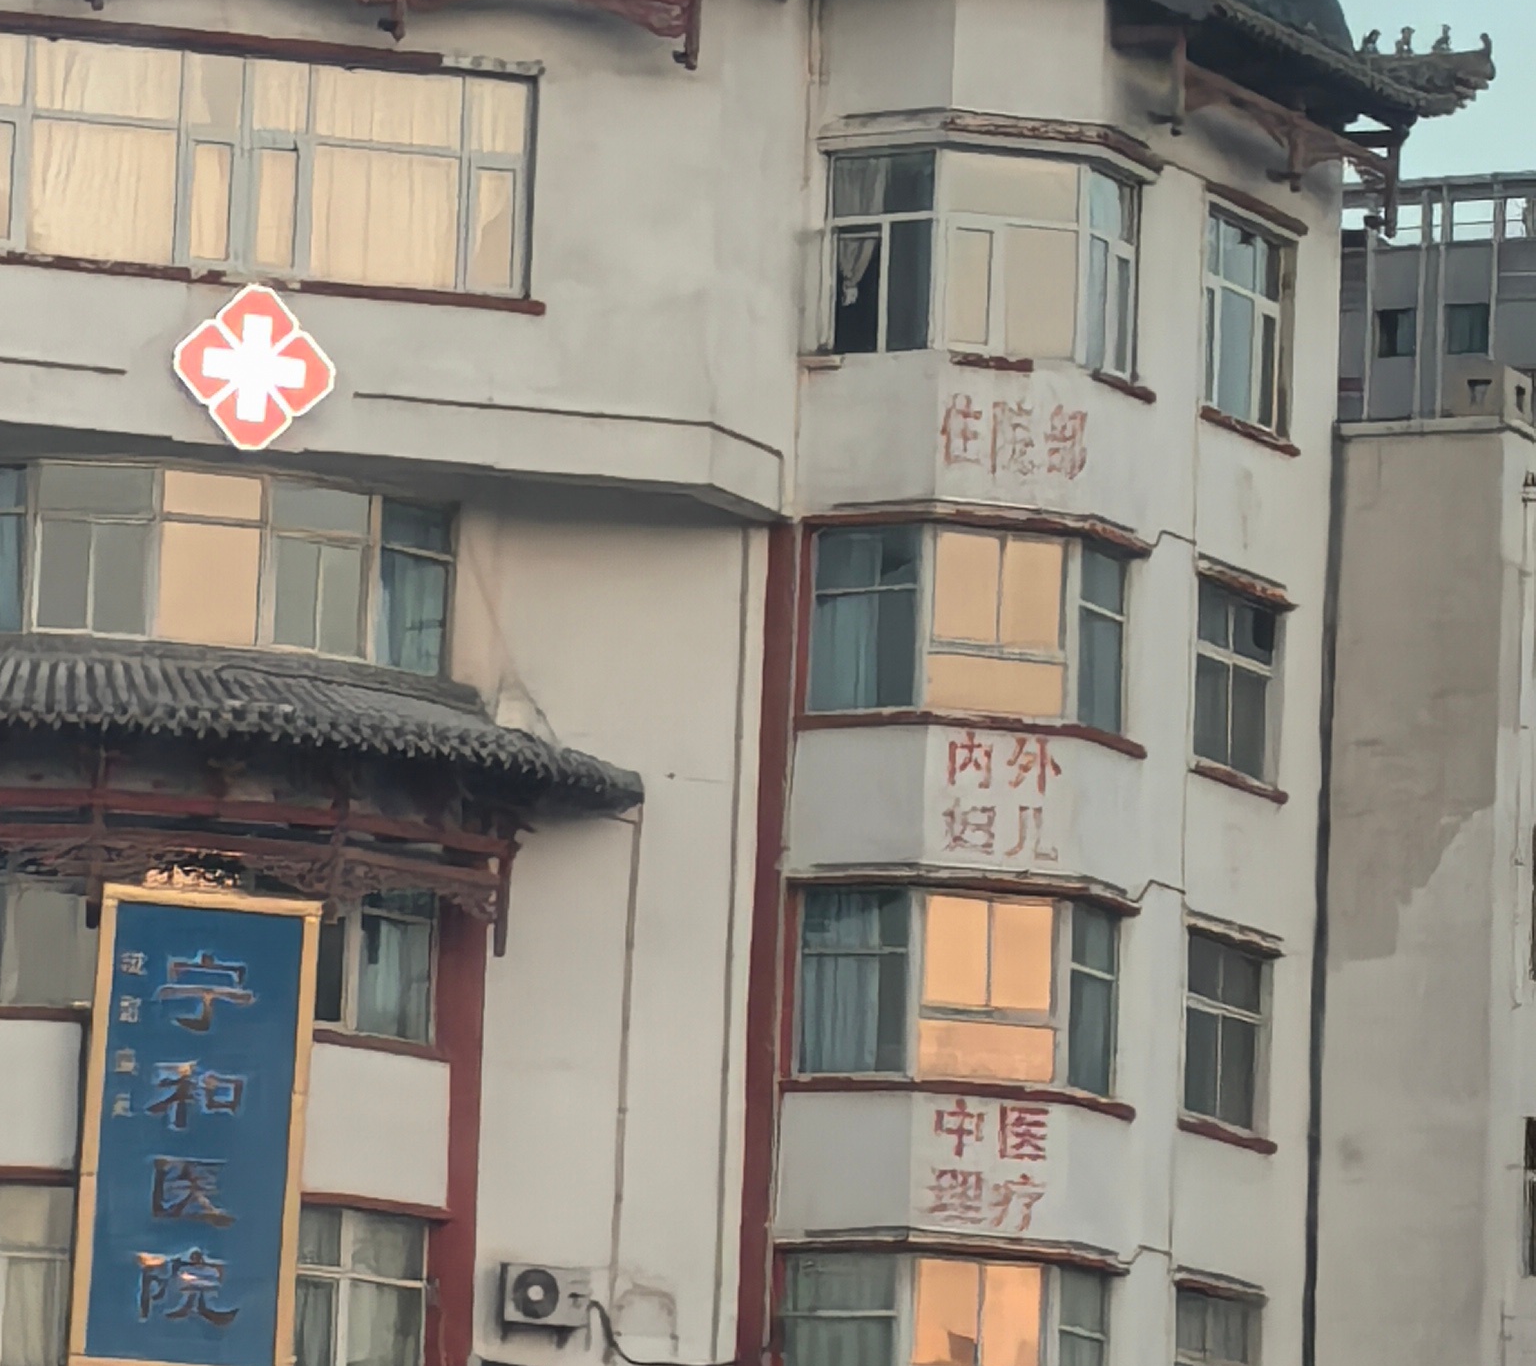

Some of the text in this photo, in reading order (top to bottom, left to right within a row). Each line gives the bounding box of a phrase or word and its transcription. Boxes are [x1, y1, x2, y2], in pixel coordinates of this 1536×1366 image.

[940, 392, 1088, 480] 住院部
[948, 730, 1062, 796] 内外
[133, 949, 259, 1327] 宁和医院
[934, 1098, 1051, 1161] 中医
